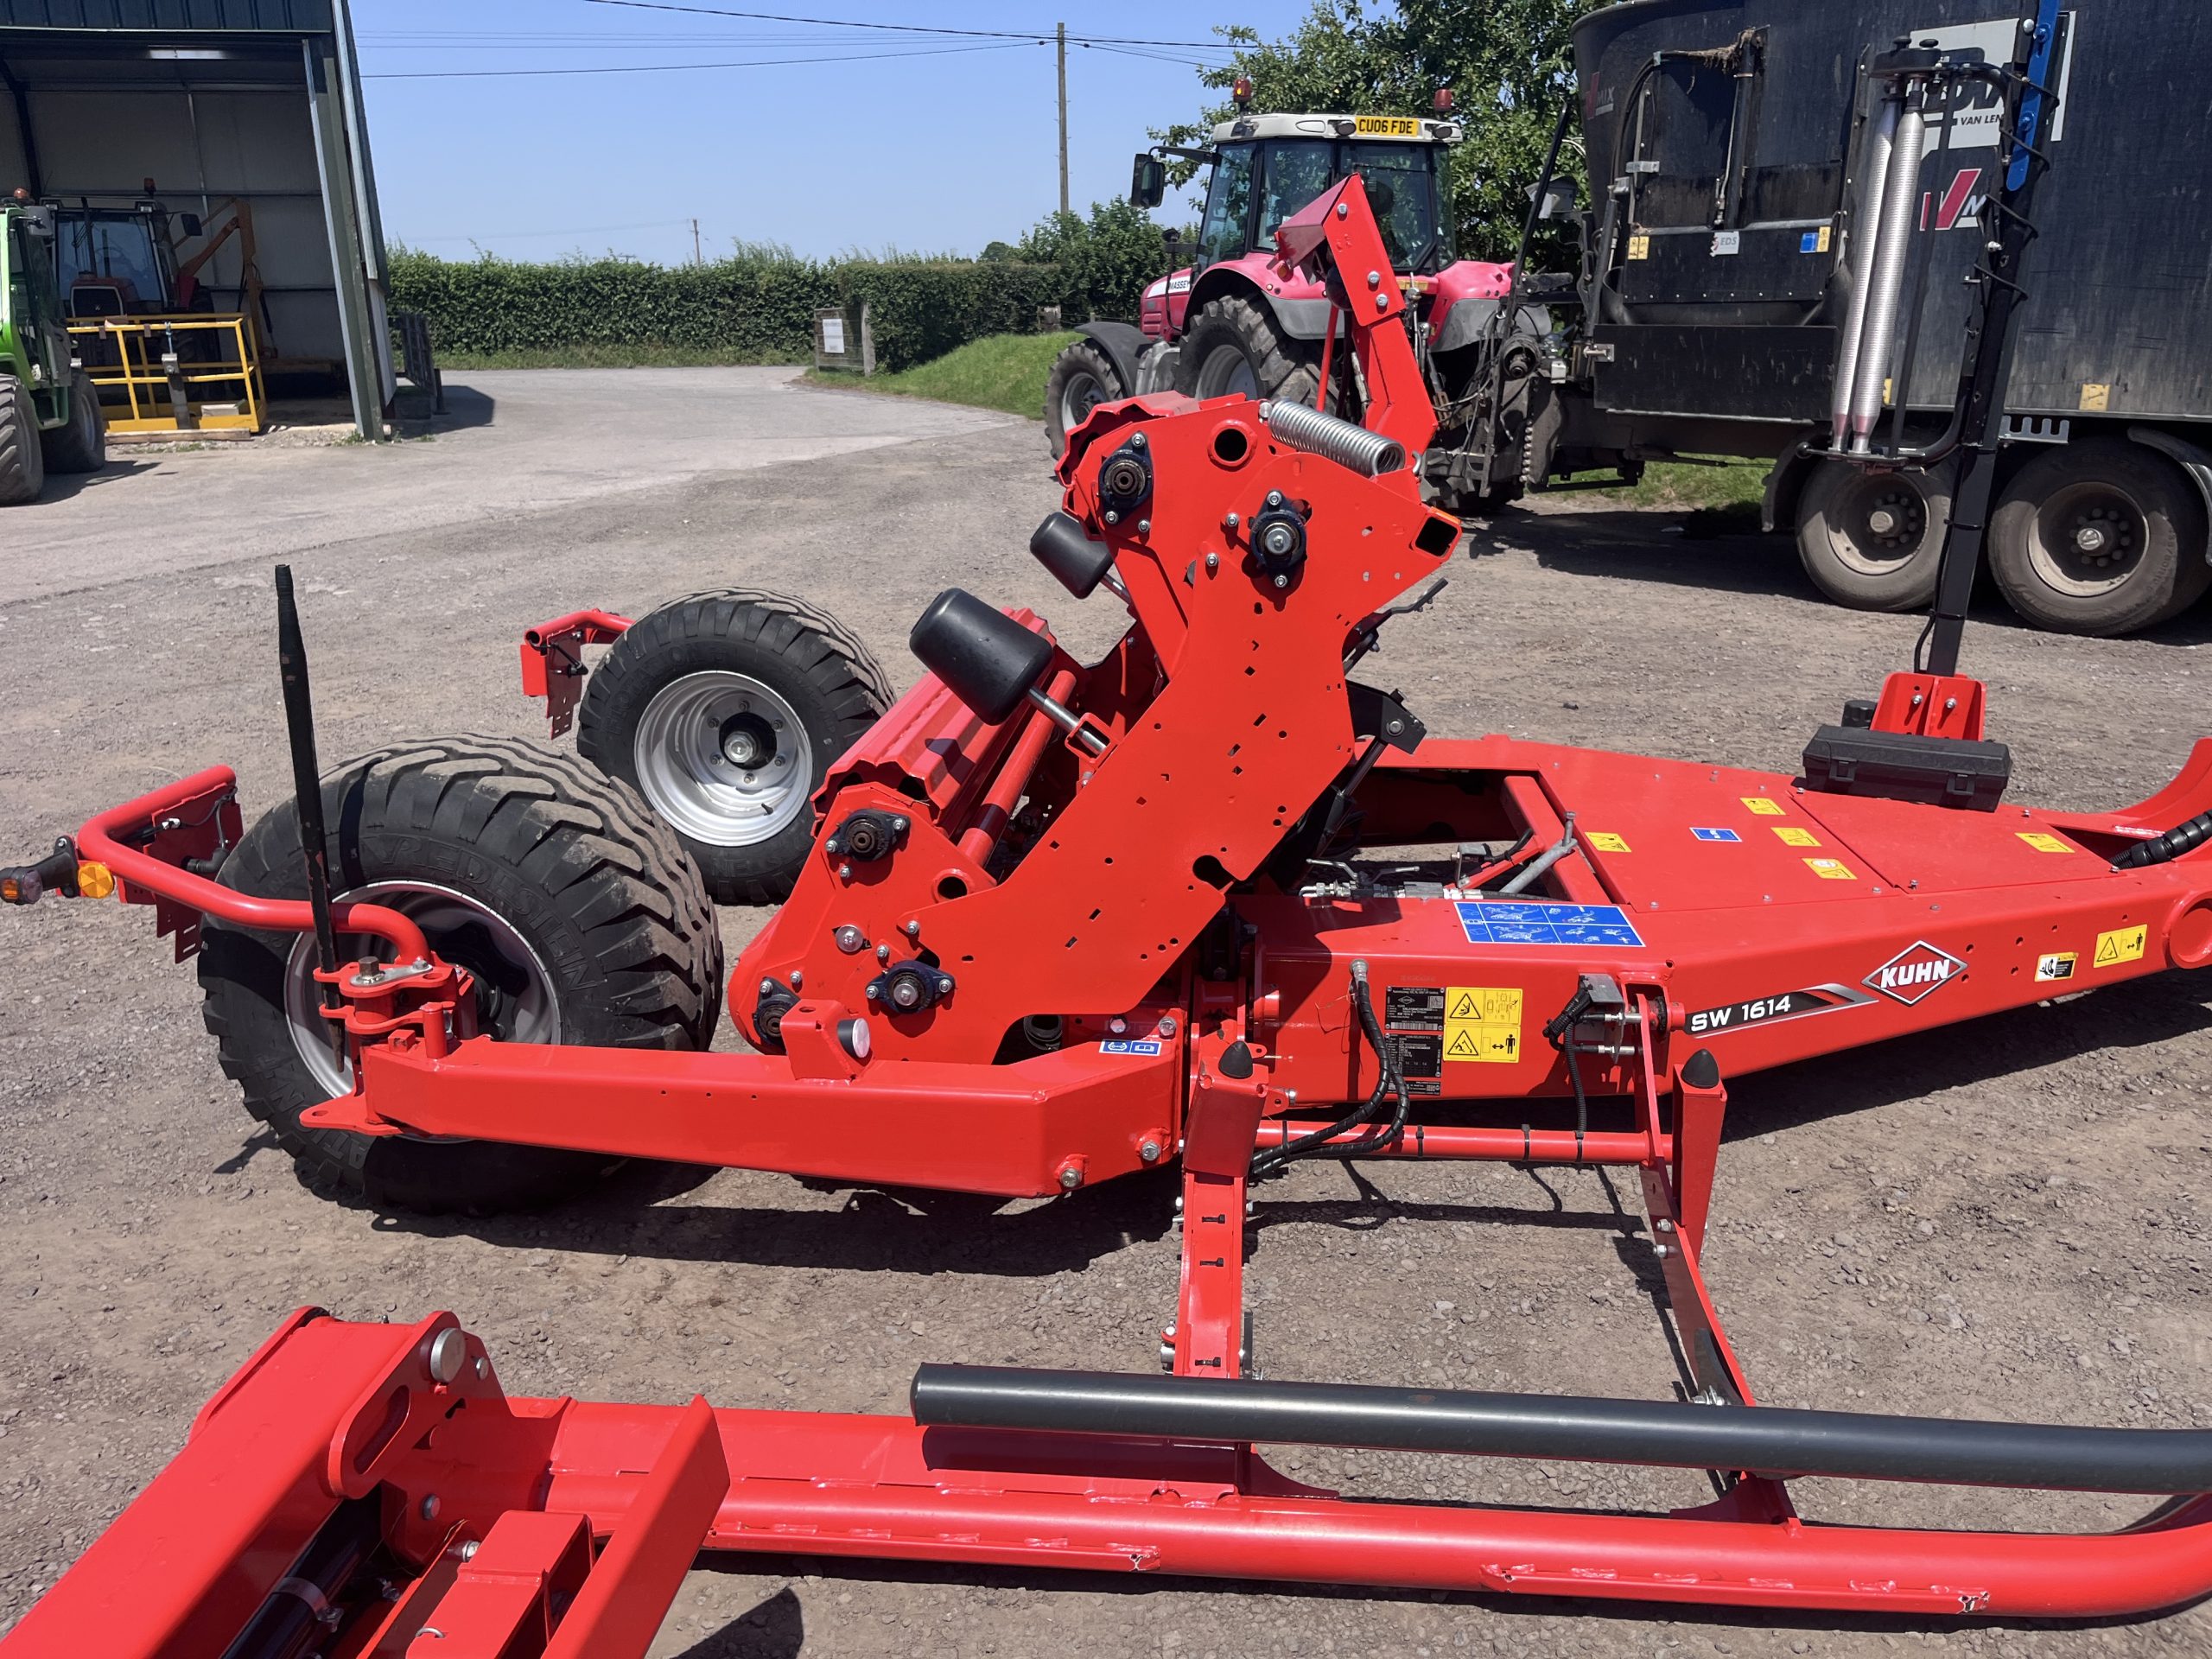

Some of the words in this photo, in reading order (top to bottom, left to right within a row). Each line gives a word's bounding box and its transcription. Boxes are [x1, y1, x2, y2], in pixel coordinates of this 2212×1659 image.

[1359, 119, 1388, 133] CU06
[1391, 120, 1413, 134] FDE
[1961, 115, 1982, 126] VAN
[1984, 113, 2003, 124] LEN
[1720, 237, 1737, 245] EDS
[1879, 959, 1950, 989] KUHN
[1691, 1007, 1731, 1032] SW
[1741, 995, 1791, 1020] 1614
